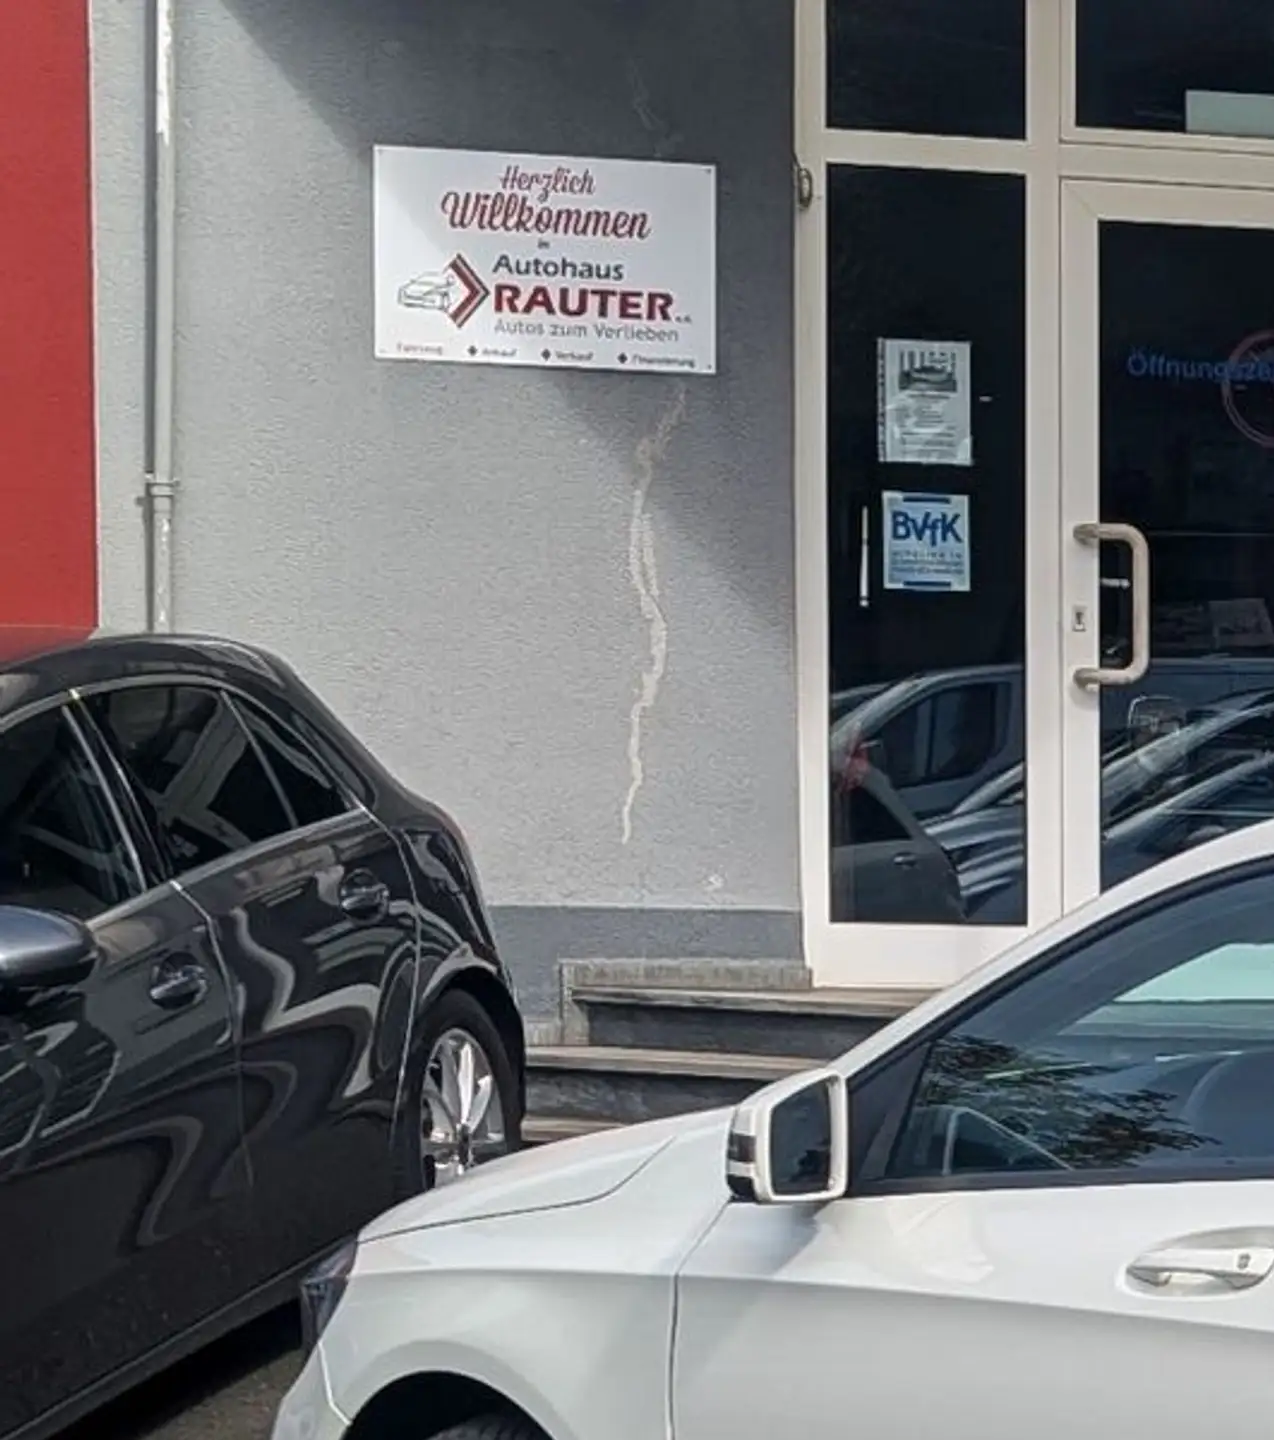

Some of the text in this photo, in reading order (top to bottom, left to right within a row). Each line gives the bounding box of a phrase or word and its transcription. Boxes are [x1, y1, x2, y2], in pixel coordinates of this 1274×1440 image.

[500, 165, 596, 203] Herzlich
[441, 190, 652, 240] Willkommen
[492, 254, 624, 281] Autohaus
[494, 283, 674, 321] RAUTER
[494, 319, 679, 343] Autos zum Verlieben
[892, 510, 963, 547] BVfK
